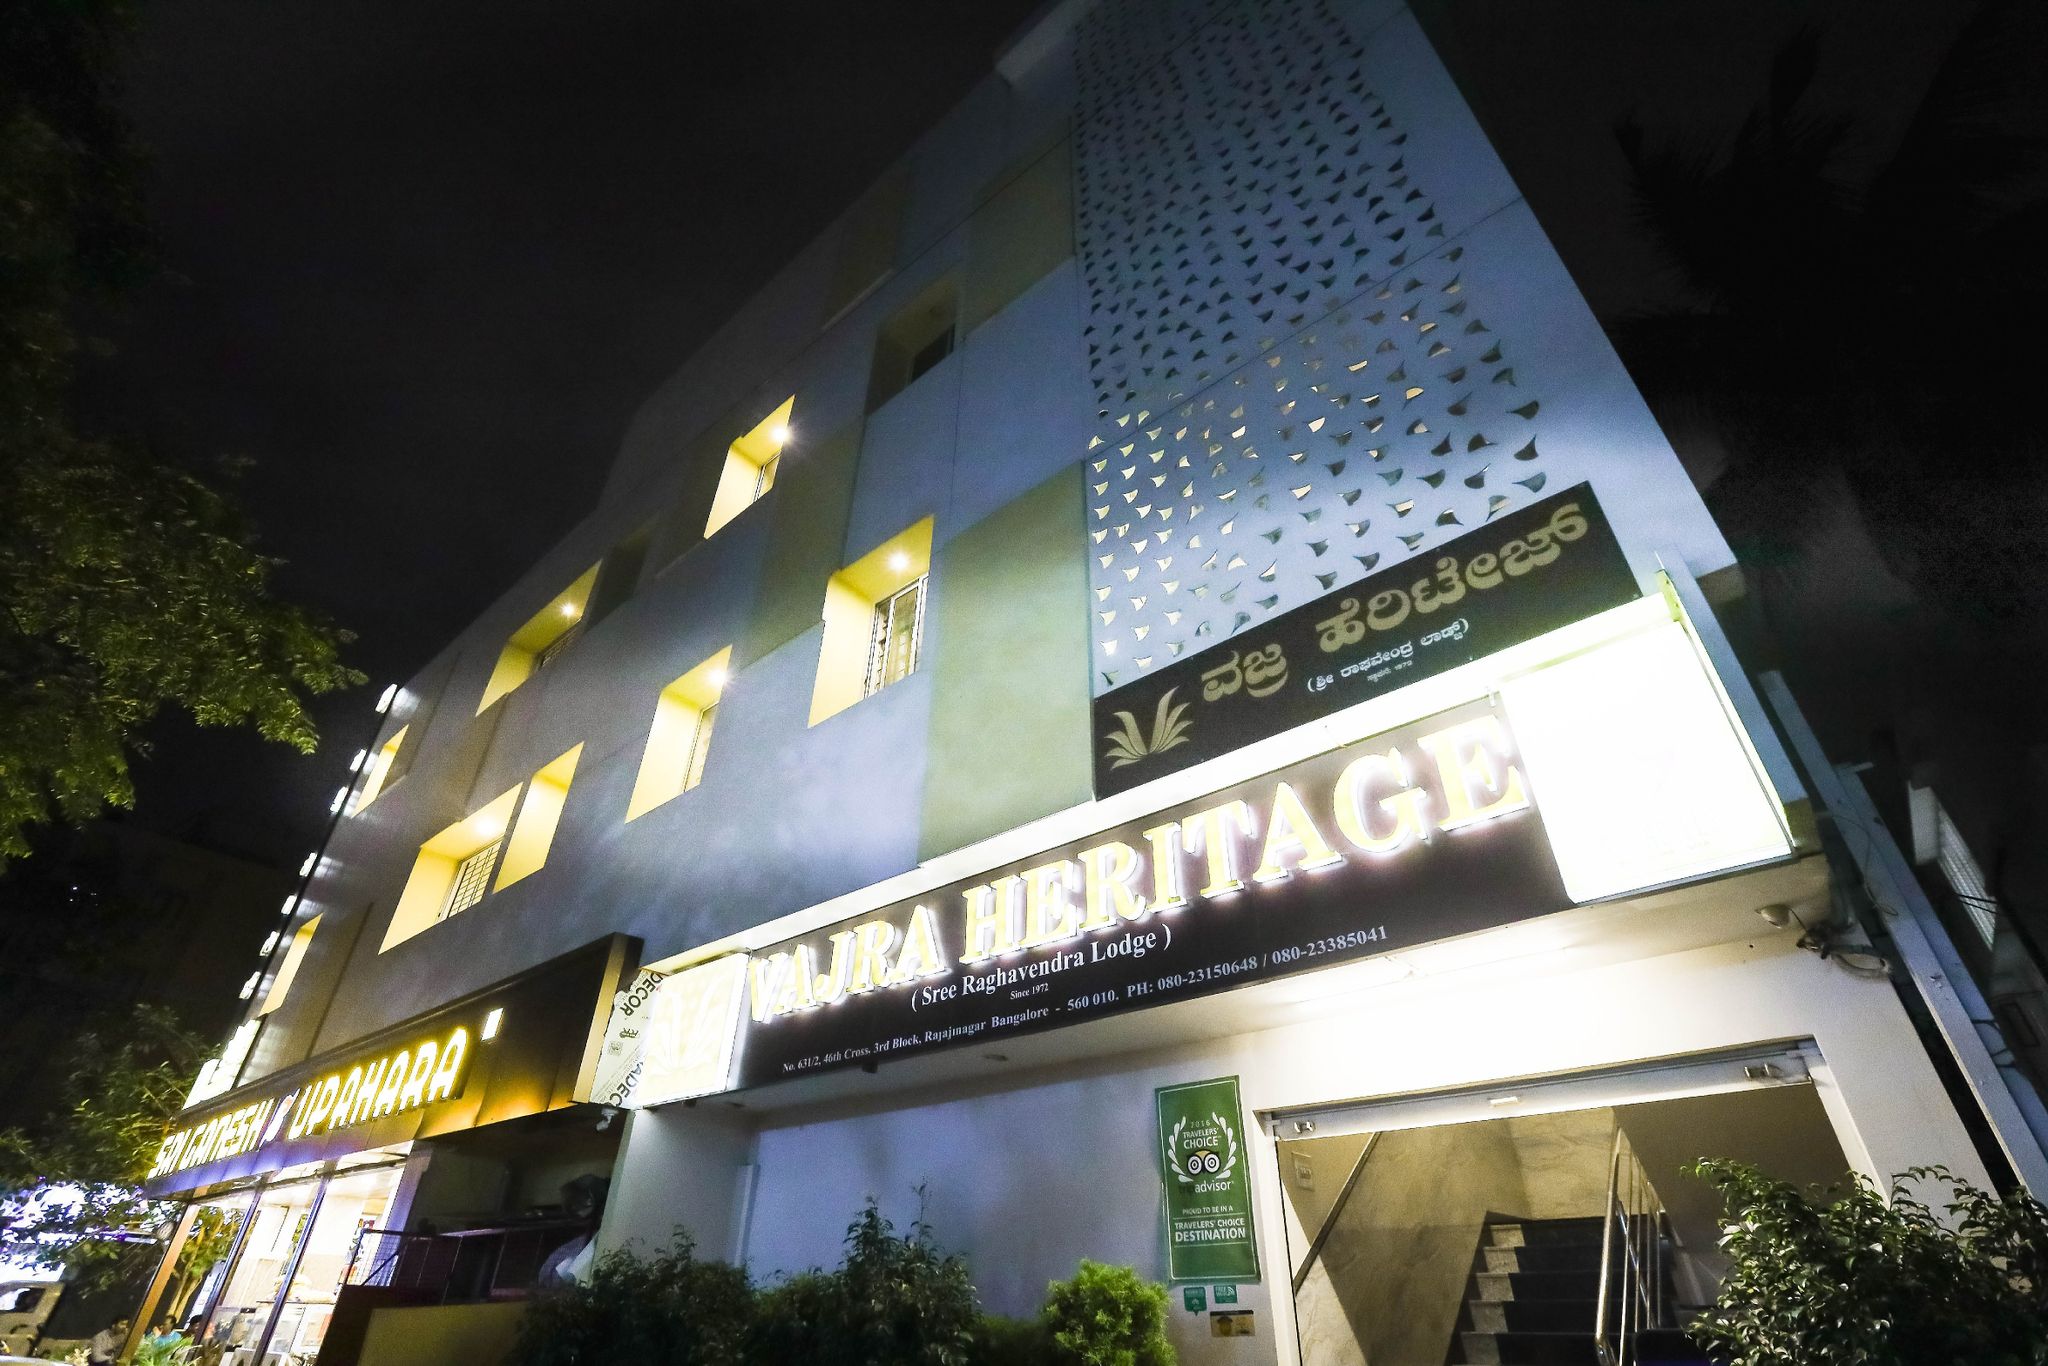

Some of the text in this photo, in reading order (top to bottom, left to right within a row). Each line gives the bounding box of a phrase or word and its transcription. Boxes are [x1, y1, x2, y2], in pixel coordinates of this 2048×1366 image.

[751, 714, 1531, 1023] VAJRA HERITAGE
[962, 951, 1085, 995] Raghavendra
[823, 1051, 842, 1063] 46th
[873, 1040, 889, 1053] 3rd
[892, 1034, 922, 1049] Block,
[925, 1020, 986, 1042] Rajajinagar
[991, 1006, 1049, 1029] Bangalore
[1067, 995, 1089, 1011] 560
[1092, 989, 1119, 1006] 010.
[1127, 982, 1153, 998] PH:
[1157, 955, 1257, 991] 080-23150648
[1271, 925, 1387, 965] 080-23385041
[1010, 983, 1049, 1000] Since 1972
[147, 1127, 193, 1180] SRI
[179, 1099, 274, 1171] GANESH
[287, 1028, 468, 1140] UPAHARA
[1184, 1136, 1219, 1149] CHOICE
[1175, 1227, 1246, 1242] DESTINATION
[1217, 1218, 1245, 1227] CHOICE
